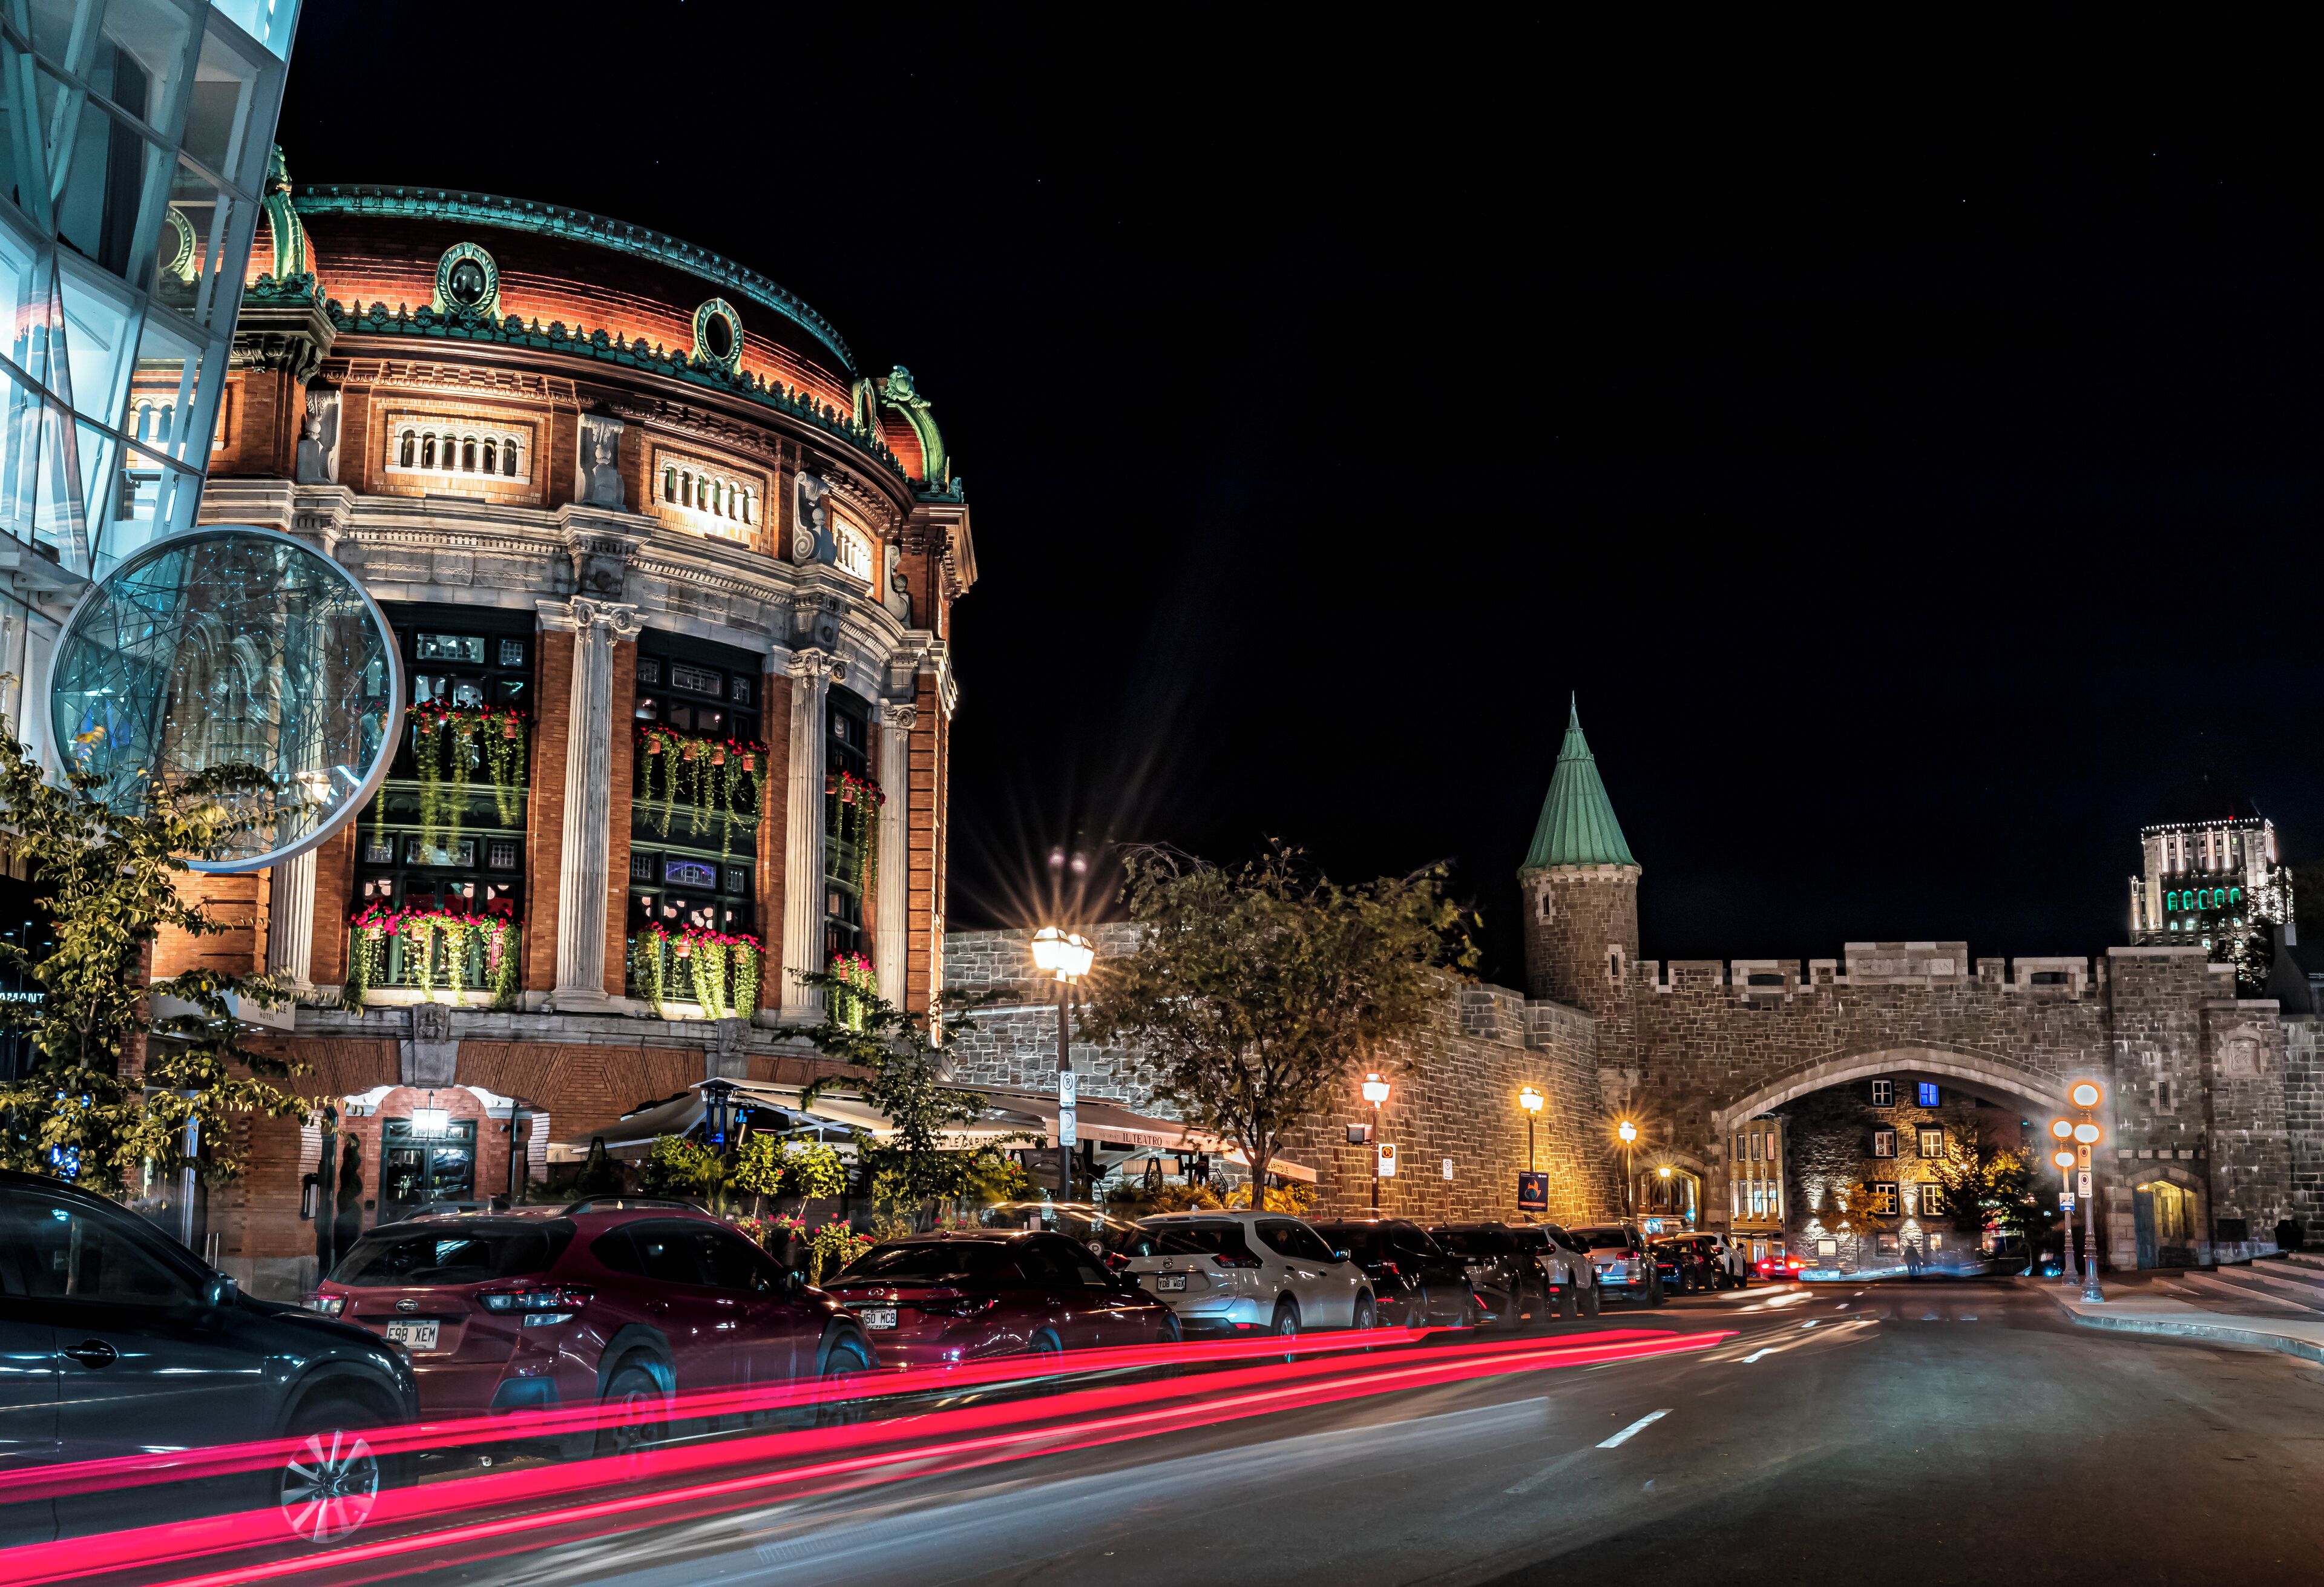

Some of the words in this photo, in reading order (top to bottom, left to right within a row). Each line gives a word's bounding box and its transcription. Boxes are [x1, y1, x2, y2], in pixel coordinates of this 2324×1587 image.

[1123, 1133, 1131, 1142] IL
[1132, 1134, 1163, 1146] TEATRO
[880, 1312, 895, 1324] MCB
[414, 1327, 436, 1342] XEM
